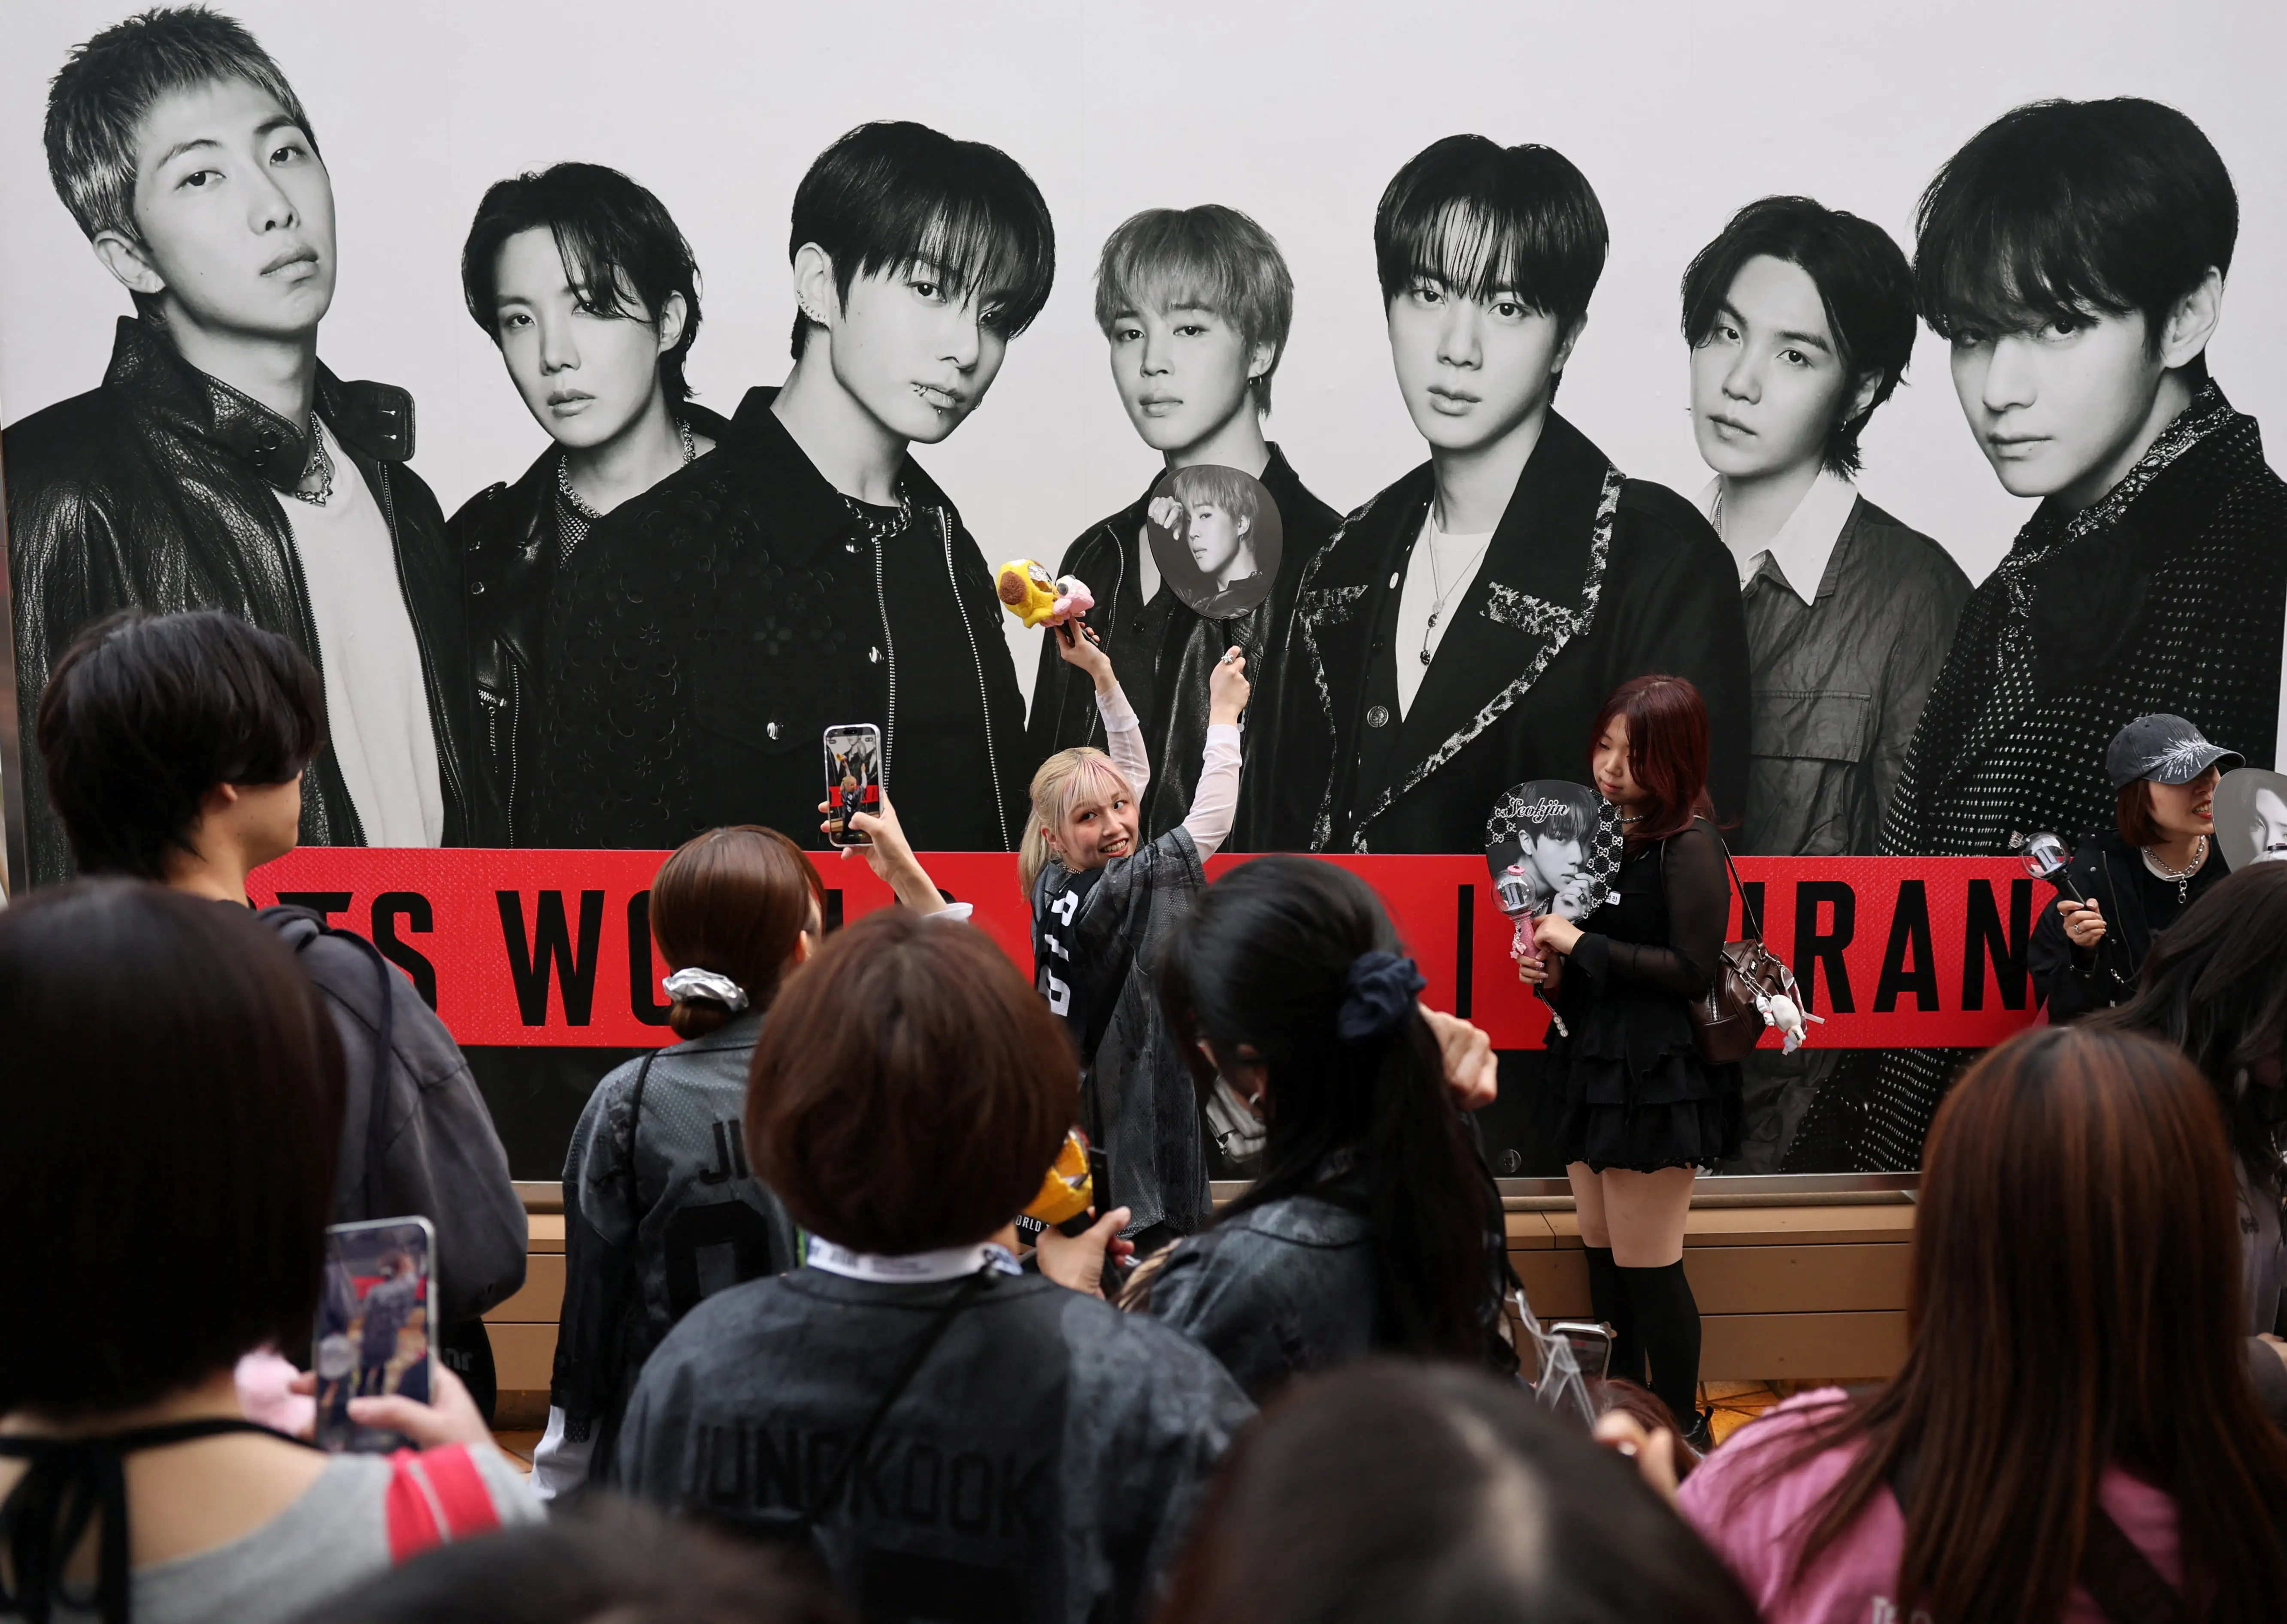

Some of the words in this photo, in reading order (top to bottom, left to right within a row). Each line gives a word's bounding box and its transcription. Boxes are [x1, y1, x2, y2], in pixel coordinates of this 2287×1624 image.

[1507, 797, 1570, 824] Seokjin
[699, 1118, 748, 1186] JI
[1015, 1215, 1042, 1232] ORLD
